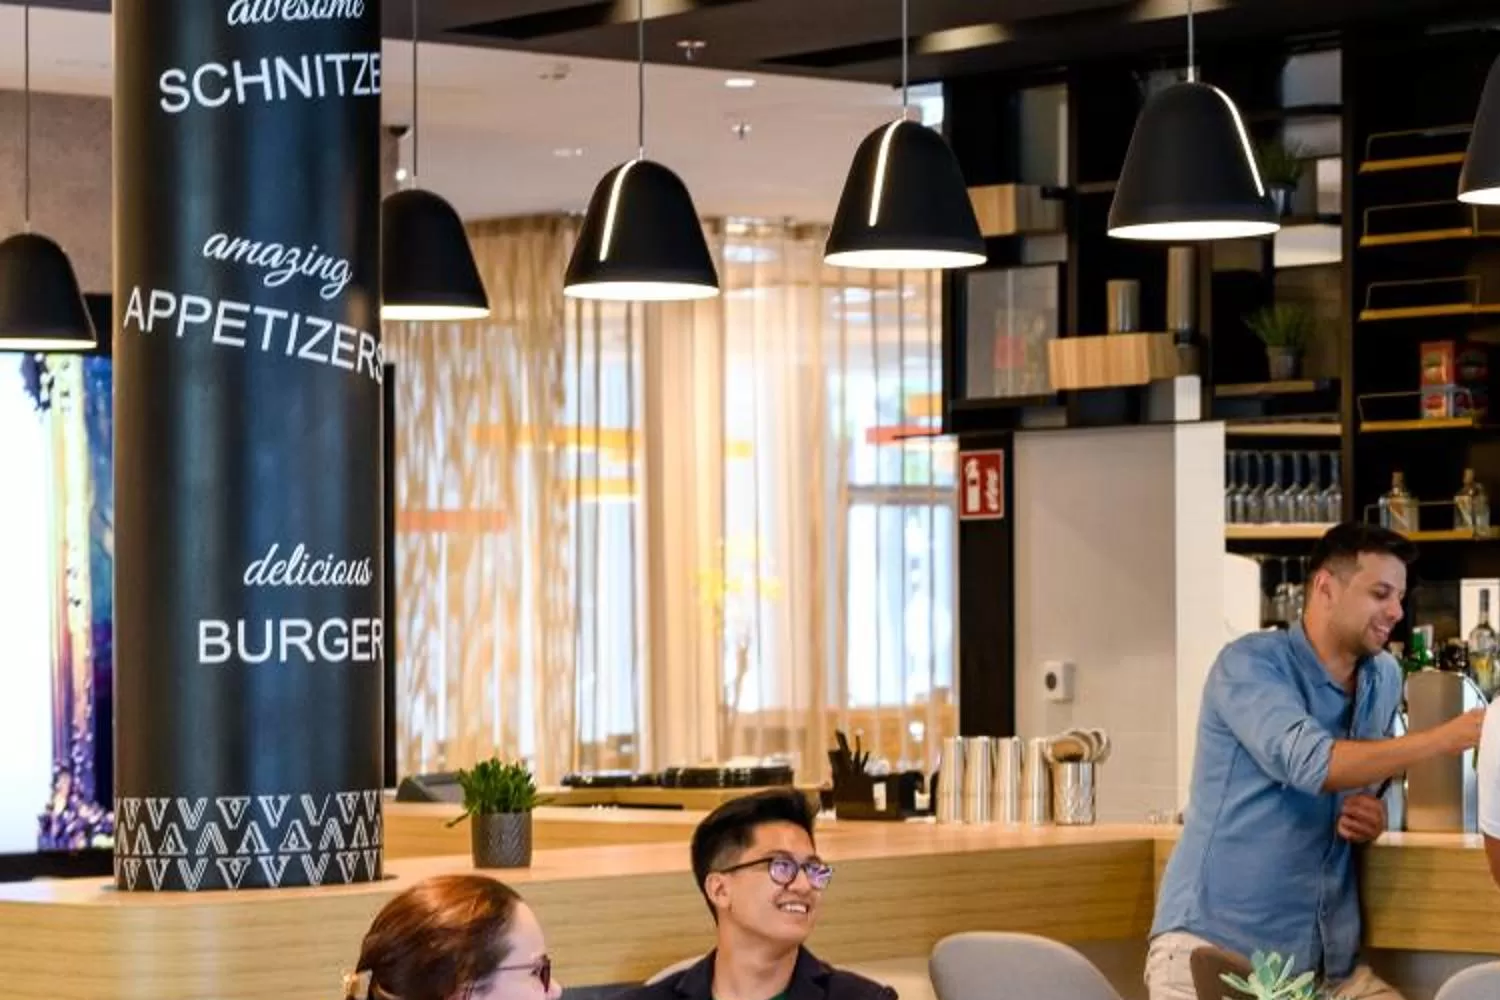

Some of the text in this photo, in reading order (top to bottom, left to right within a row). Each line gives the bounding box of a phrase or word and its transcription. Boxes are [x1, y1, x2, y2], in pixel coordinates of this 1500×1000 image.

[227, 0, 365, 26] awesome
[203, 233, 353, 300] amazing
[243, 542, 372, 587] delicious
[198, 617, 384, 664] BURGER
